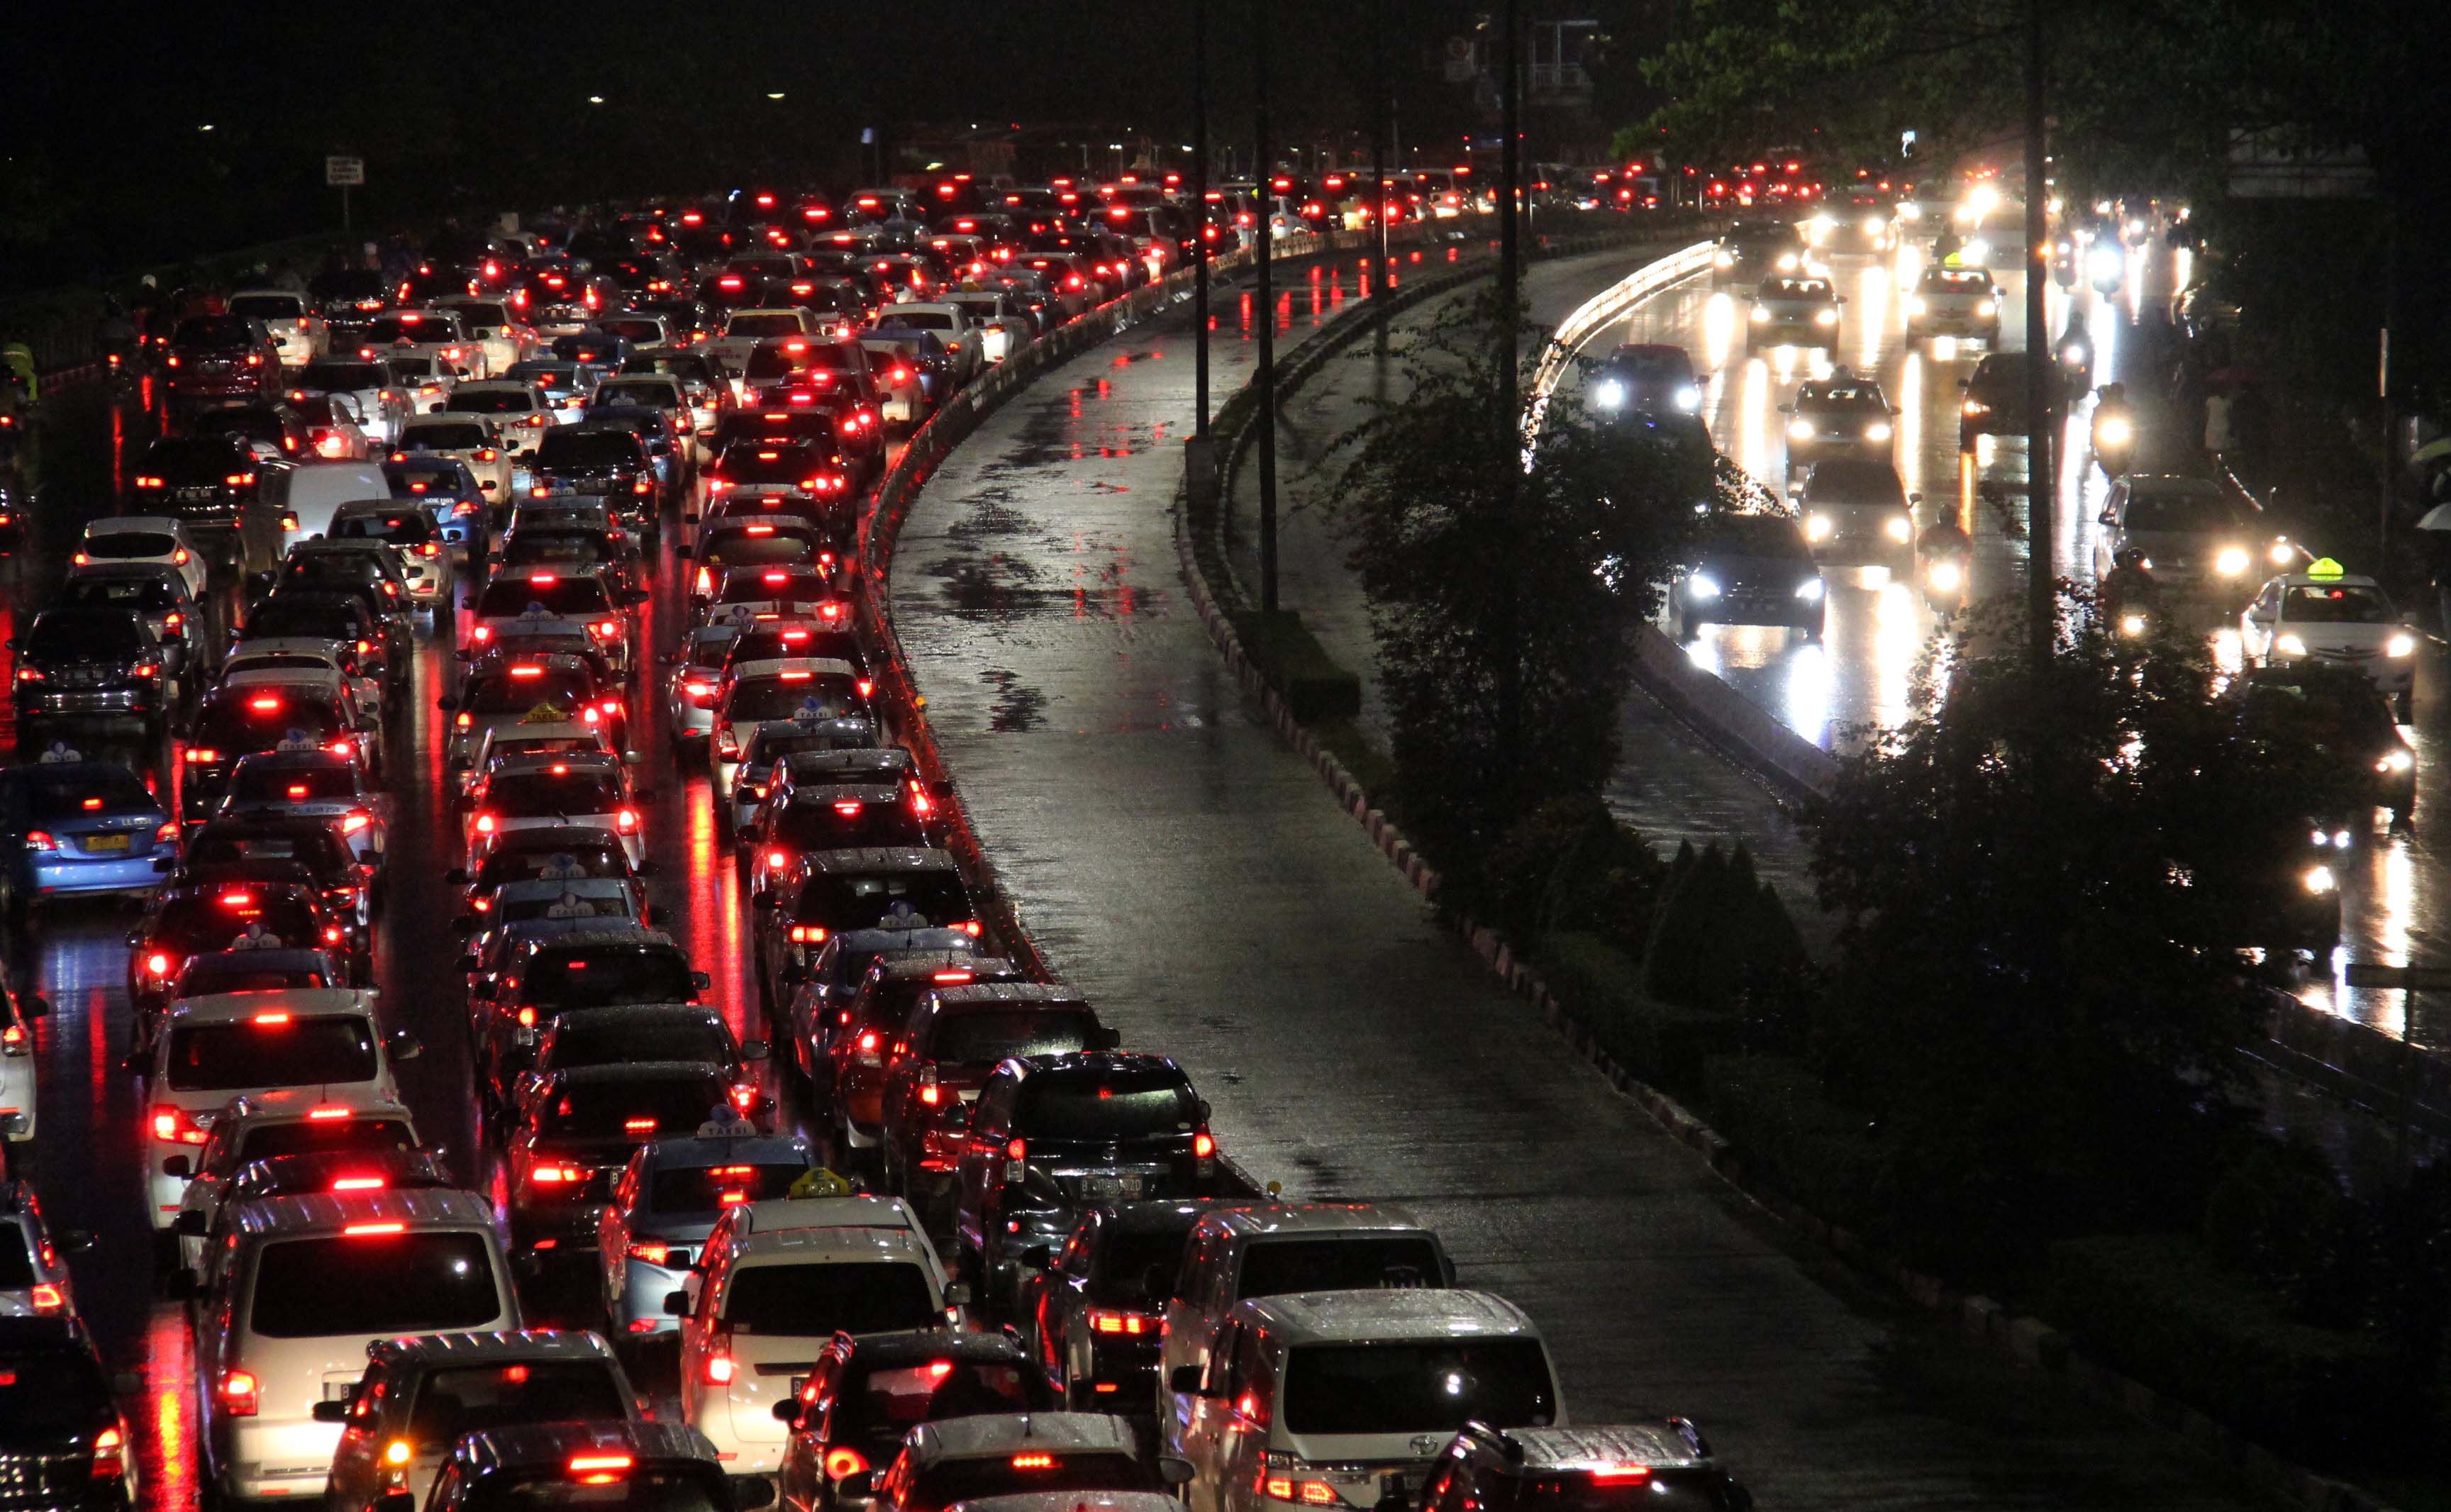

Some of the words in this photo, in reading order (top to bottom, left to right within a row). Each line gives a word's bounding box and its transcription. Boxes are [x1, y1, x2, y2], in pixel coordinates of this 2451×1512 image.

[708, 1126, 746, 1135] TAKSI
[612, 1173, 618, 1185] B
[1082, 1179, 1088, 1192] B
[343, 1385, 349, 1398] B
